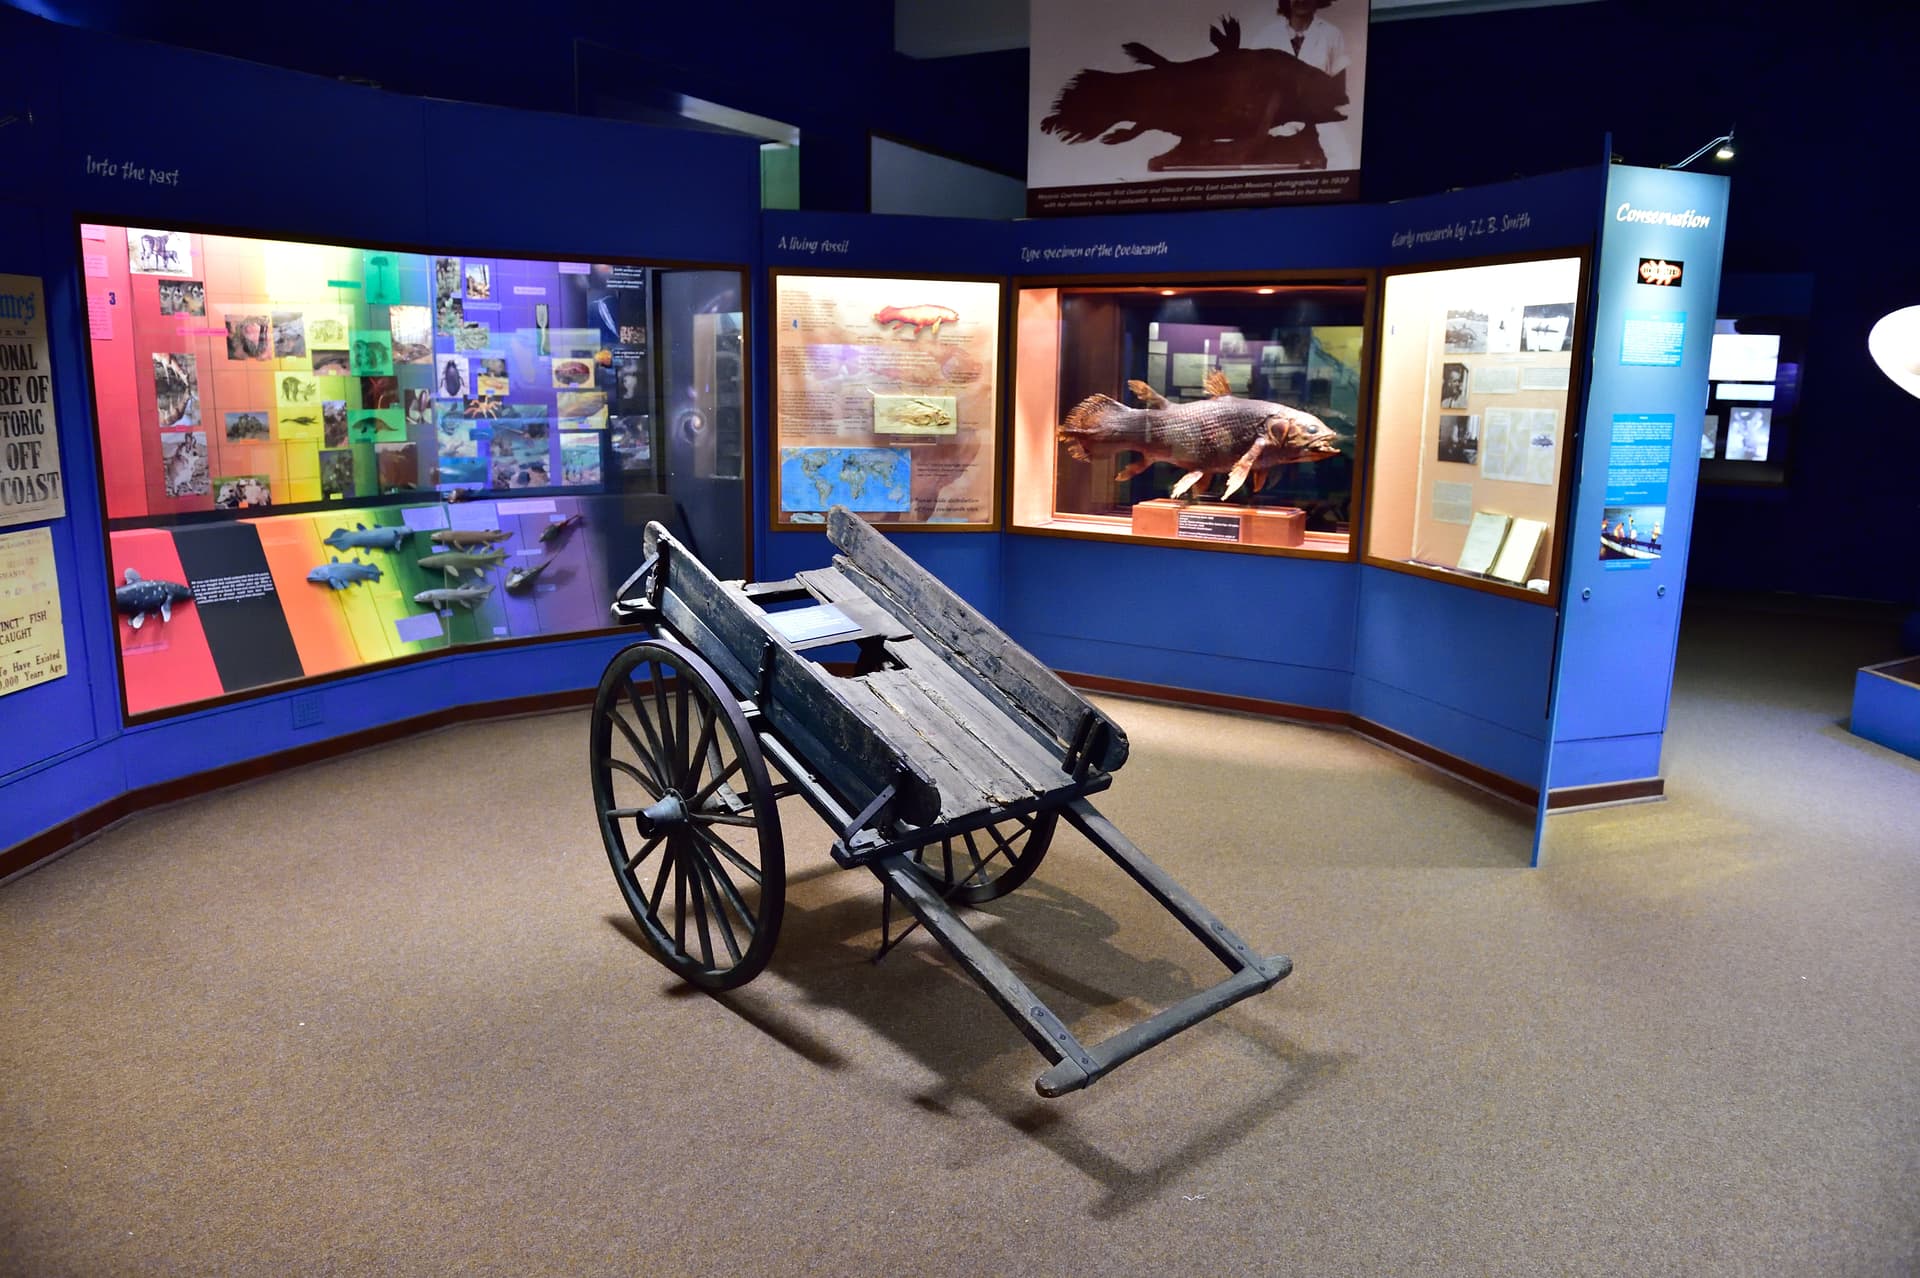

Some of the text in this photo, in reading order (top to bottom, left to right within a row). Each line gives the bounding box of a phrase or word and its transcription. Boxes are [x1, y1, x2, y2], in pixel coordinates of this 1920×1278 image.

[86, 154, 180, 187] Into the past
[1616, 201, 1711, 229] Conservation
[1391, 229, 1416, 249] Early
[1416, 224, 1454, 244] research
[1454, 222, 1468, 242] by
[1500, 211, 1531, 233] Smith
[777, 235, 850, 255] A living fossil
[1020, 240, 1169, 264] Type specimen of the Coelacanth
[108, 291, 117, 306] 3
[0, 343, 39, 372] ONAL
[26, 375, 50, 405] OF
[0, 408, 45, 438] TORIC
[7, 440, 42, 472] OFF
[1, 471, 61, 507] COAST
[29, 609, 48, 624] FISH
[0, 626, 32, 645] CAUGHT
[12, 661, 31, 673] Have
[35, 648, 61, 666] Existed
[24, 669, 44, 682] Years
[49, 663, 63, 674] Ago
